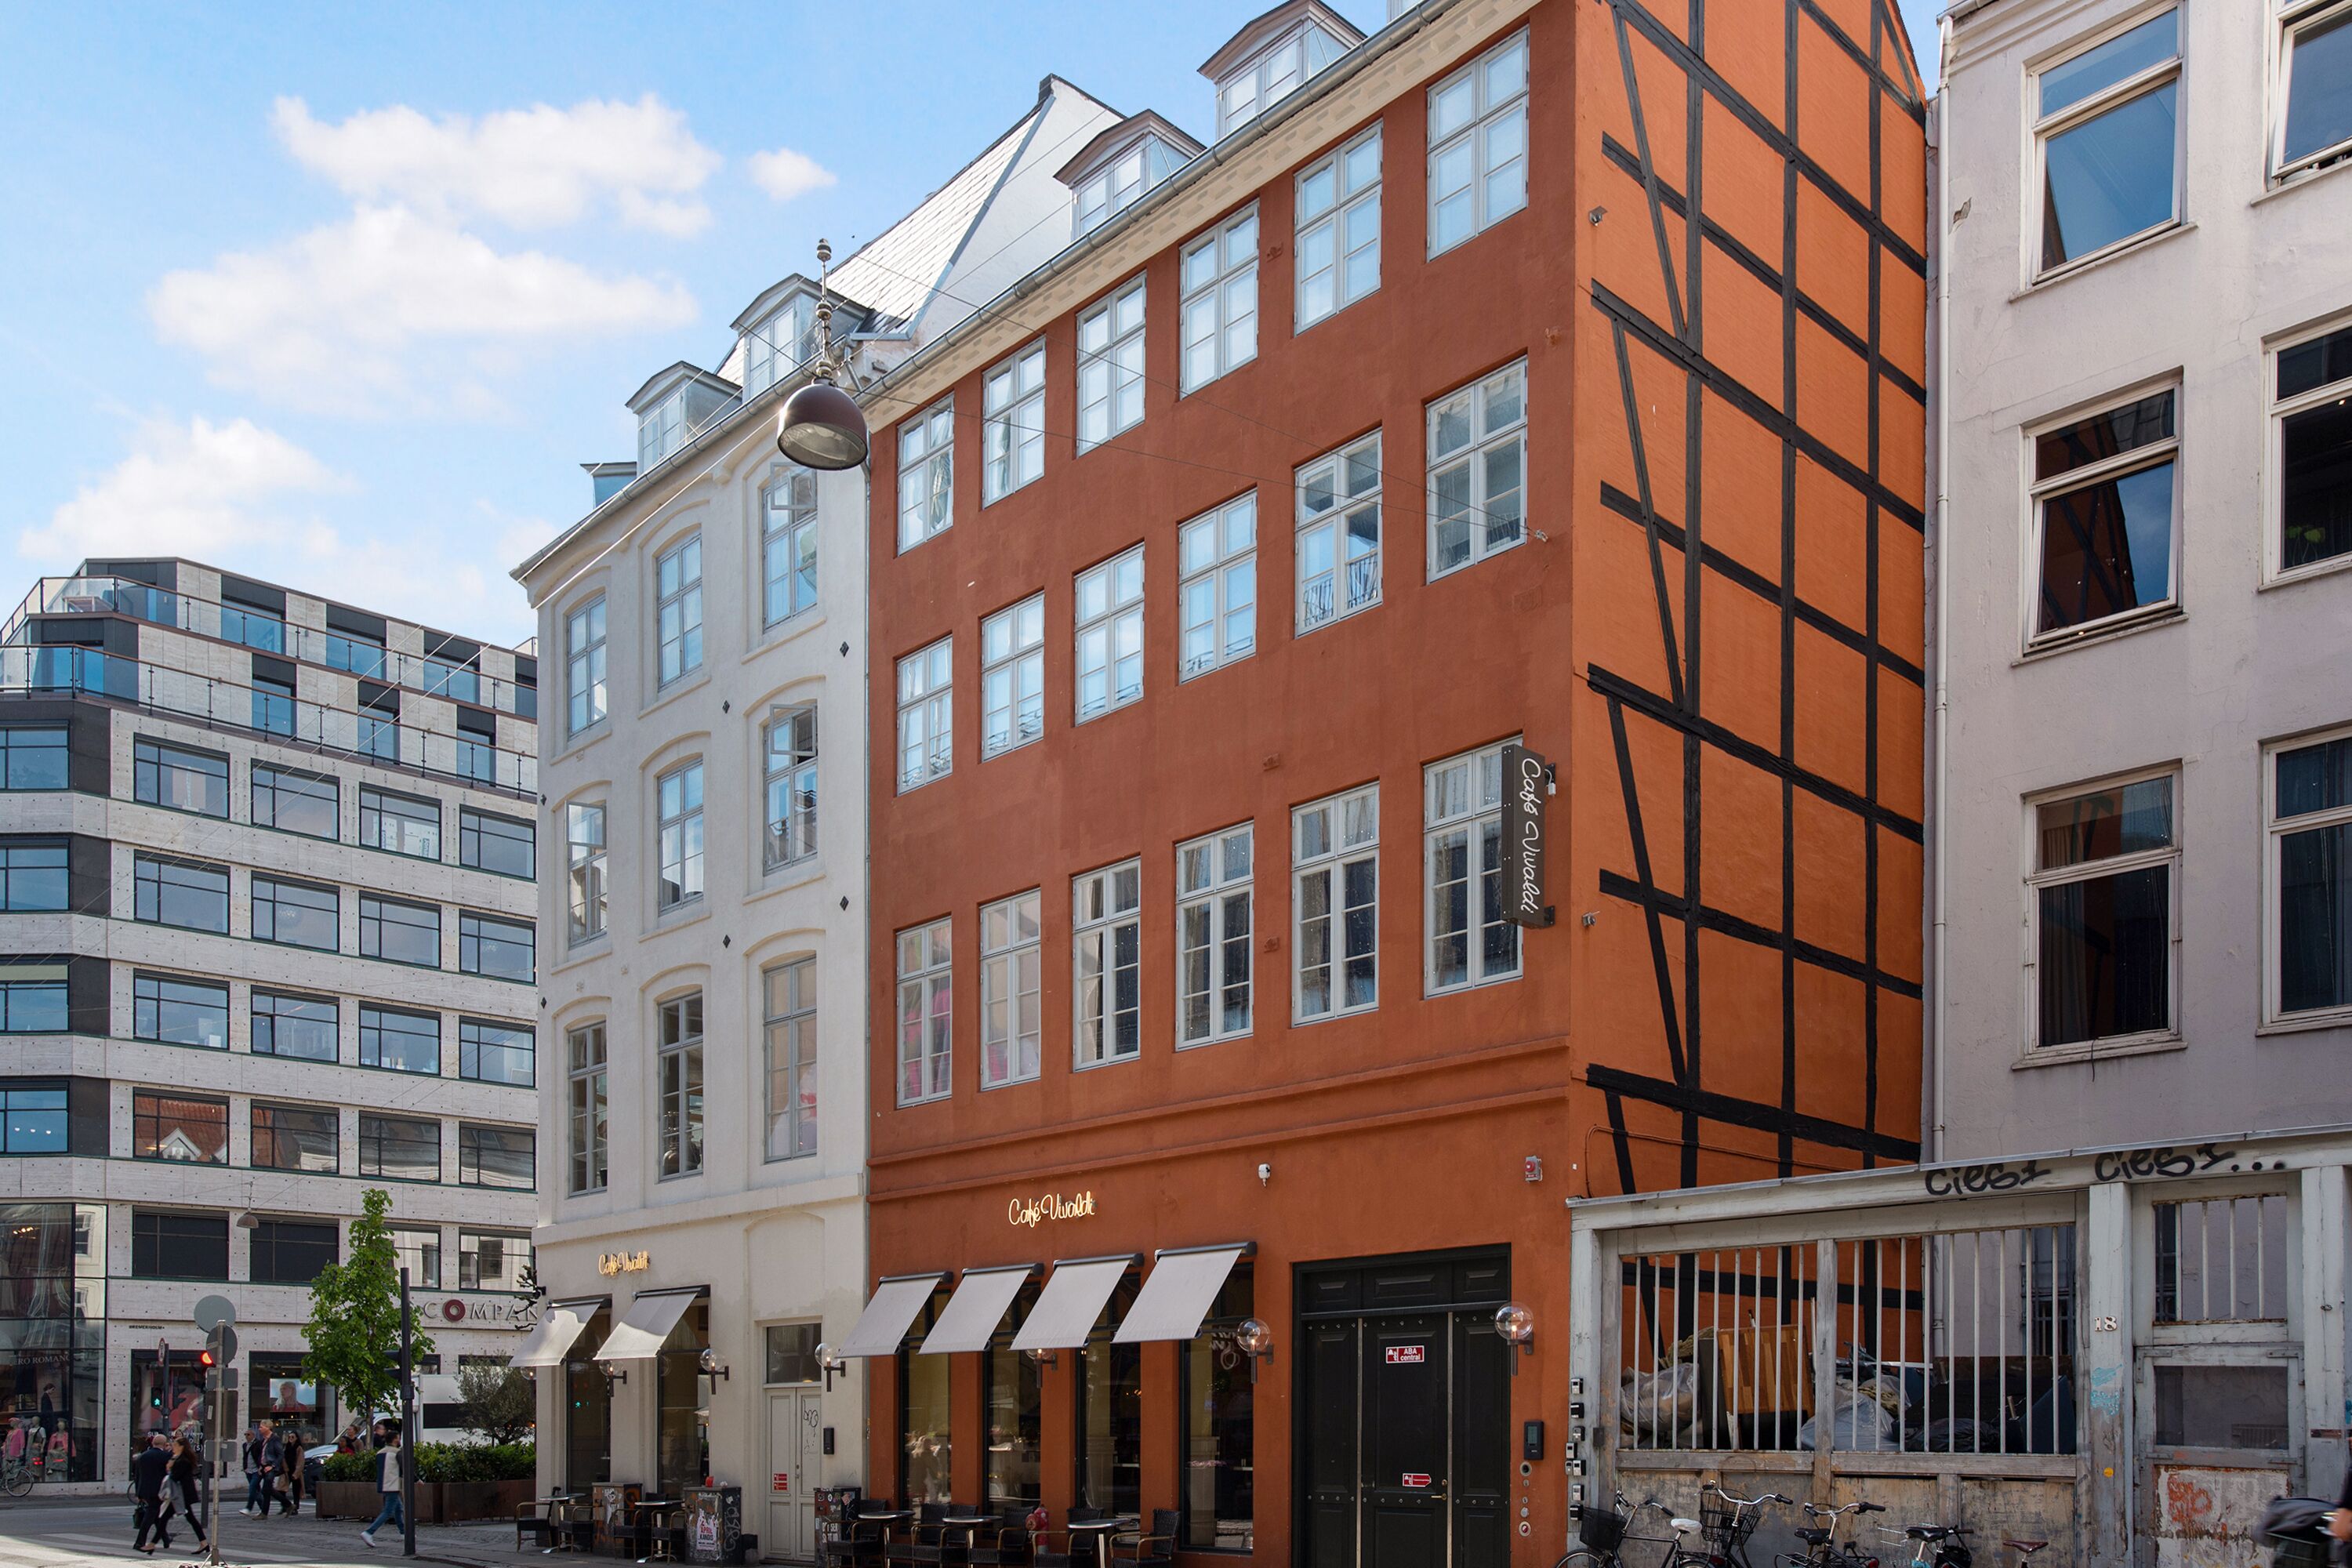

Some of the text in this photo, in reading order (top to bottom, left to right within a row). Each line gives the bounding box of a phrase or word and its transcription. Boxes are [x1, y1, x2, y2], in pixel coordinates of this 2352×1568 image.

[1519, 758, 1541, 913] Café Vivaldi
[1008, 1191, 1095, 1228] Café Vivaldi
[2094, 1316, 2118, 1332] 18
